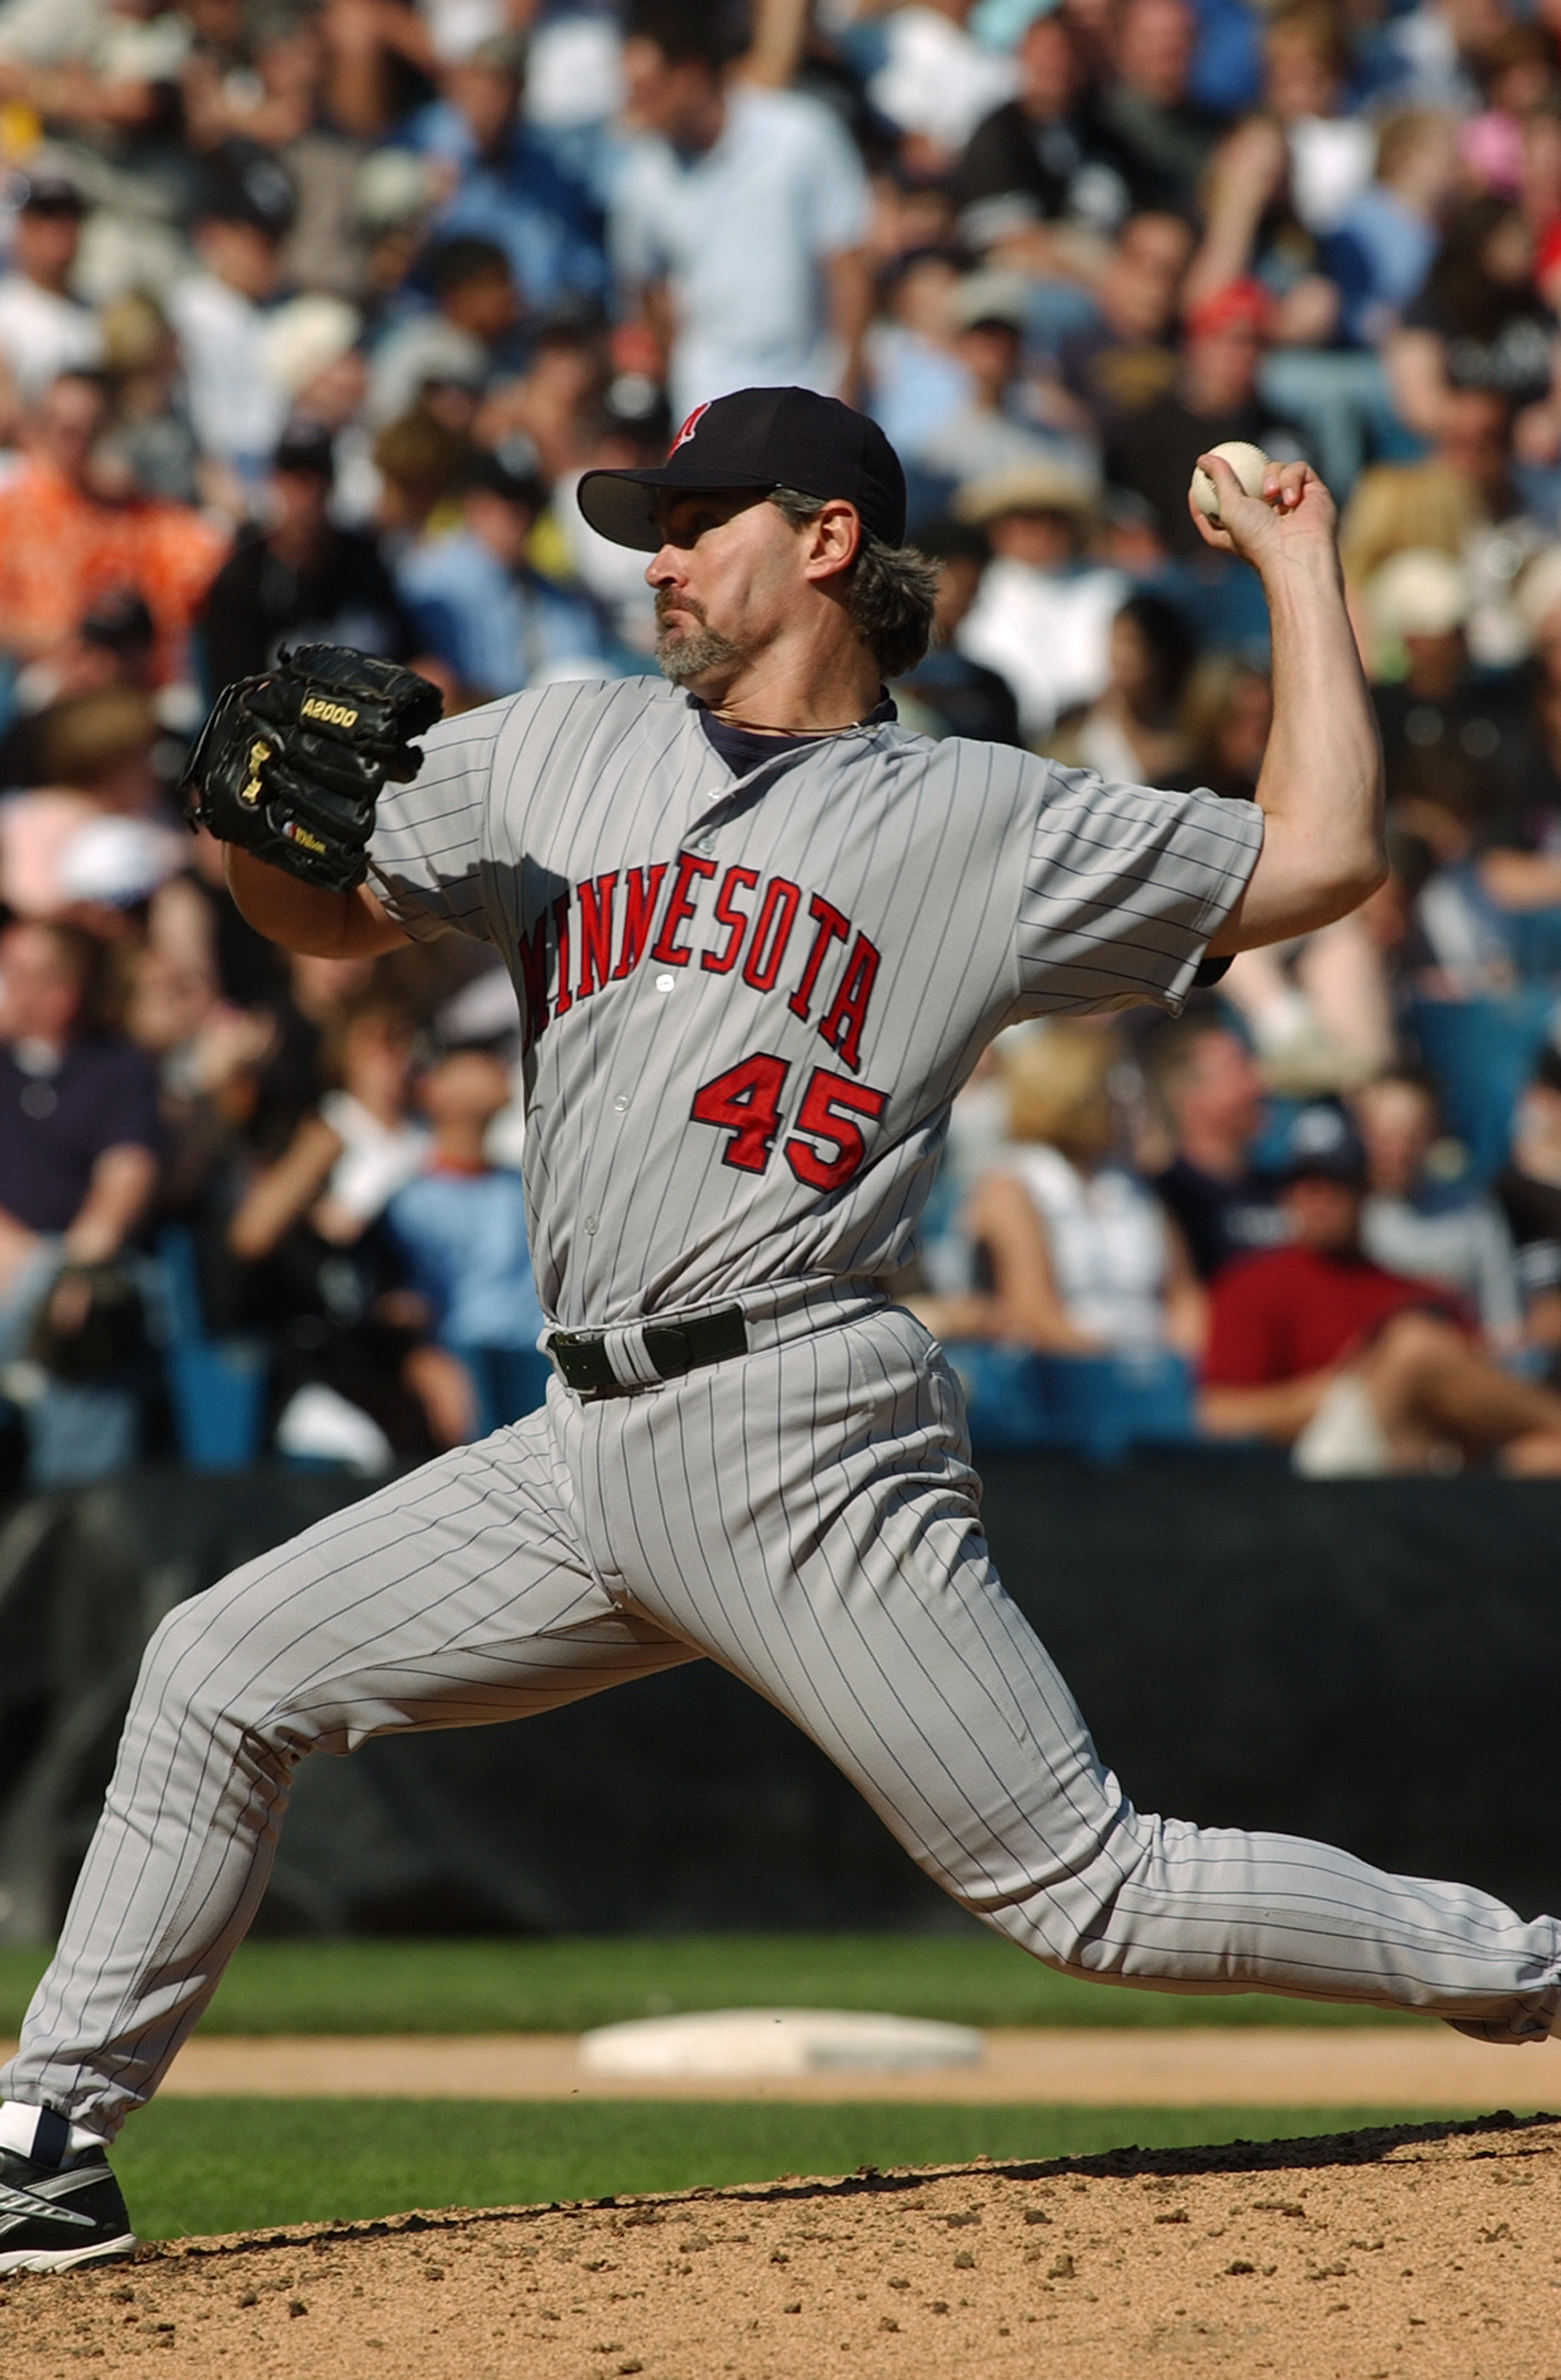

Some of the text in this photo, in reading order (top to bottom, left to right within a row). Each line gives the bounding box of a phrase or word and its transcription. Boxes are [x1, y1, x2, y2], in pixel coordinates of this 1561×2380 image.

[300, 698, 359, 728] A2000
[519, 850, 882, 1076] MINNESOTA
[689, 1051, 892, 1195] 45
